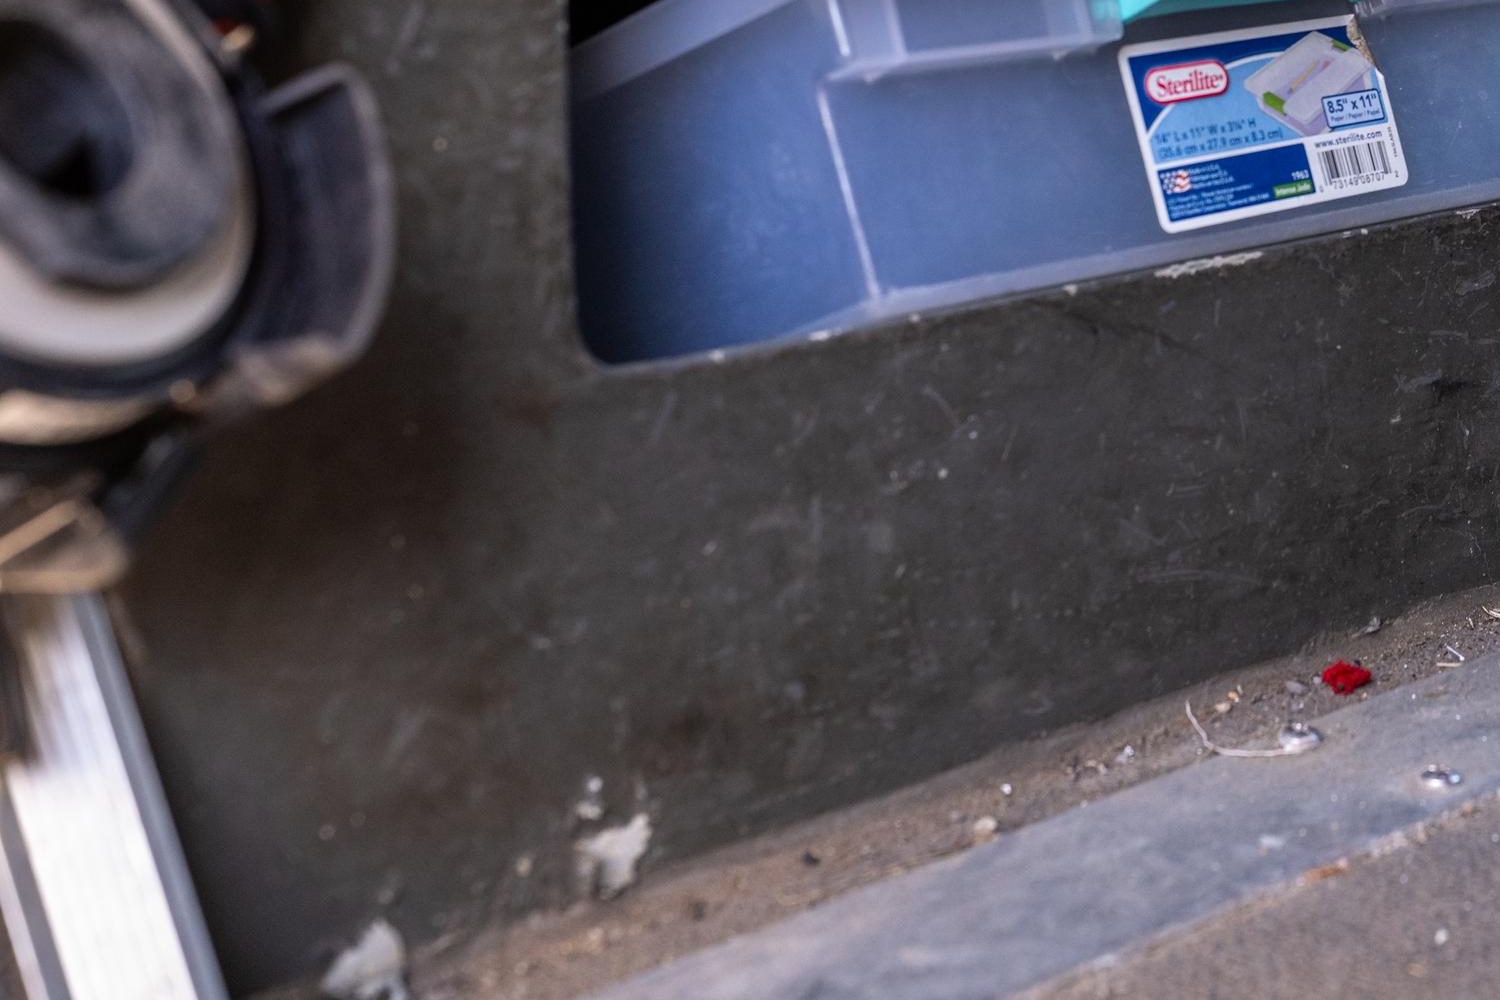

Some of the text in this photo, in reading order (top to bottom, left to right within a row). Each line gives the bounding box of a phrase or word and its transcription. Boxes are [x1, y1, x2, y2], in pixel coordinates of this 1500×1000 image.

[1155, 69, 1220, 97] Sterilite
[1327, 93, 1377, 114] 8.5" x 11"
[1314, 130, 1383, 149] www.sterilite.com
[1332, 175, 1359, 191] 73149
[1360, 171, 1386, 185] 08707
